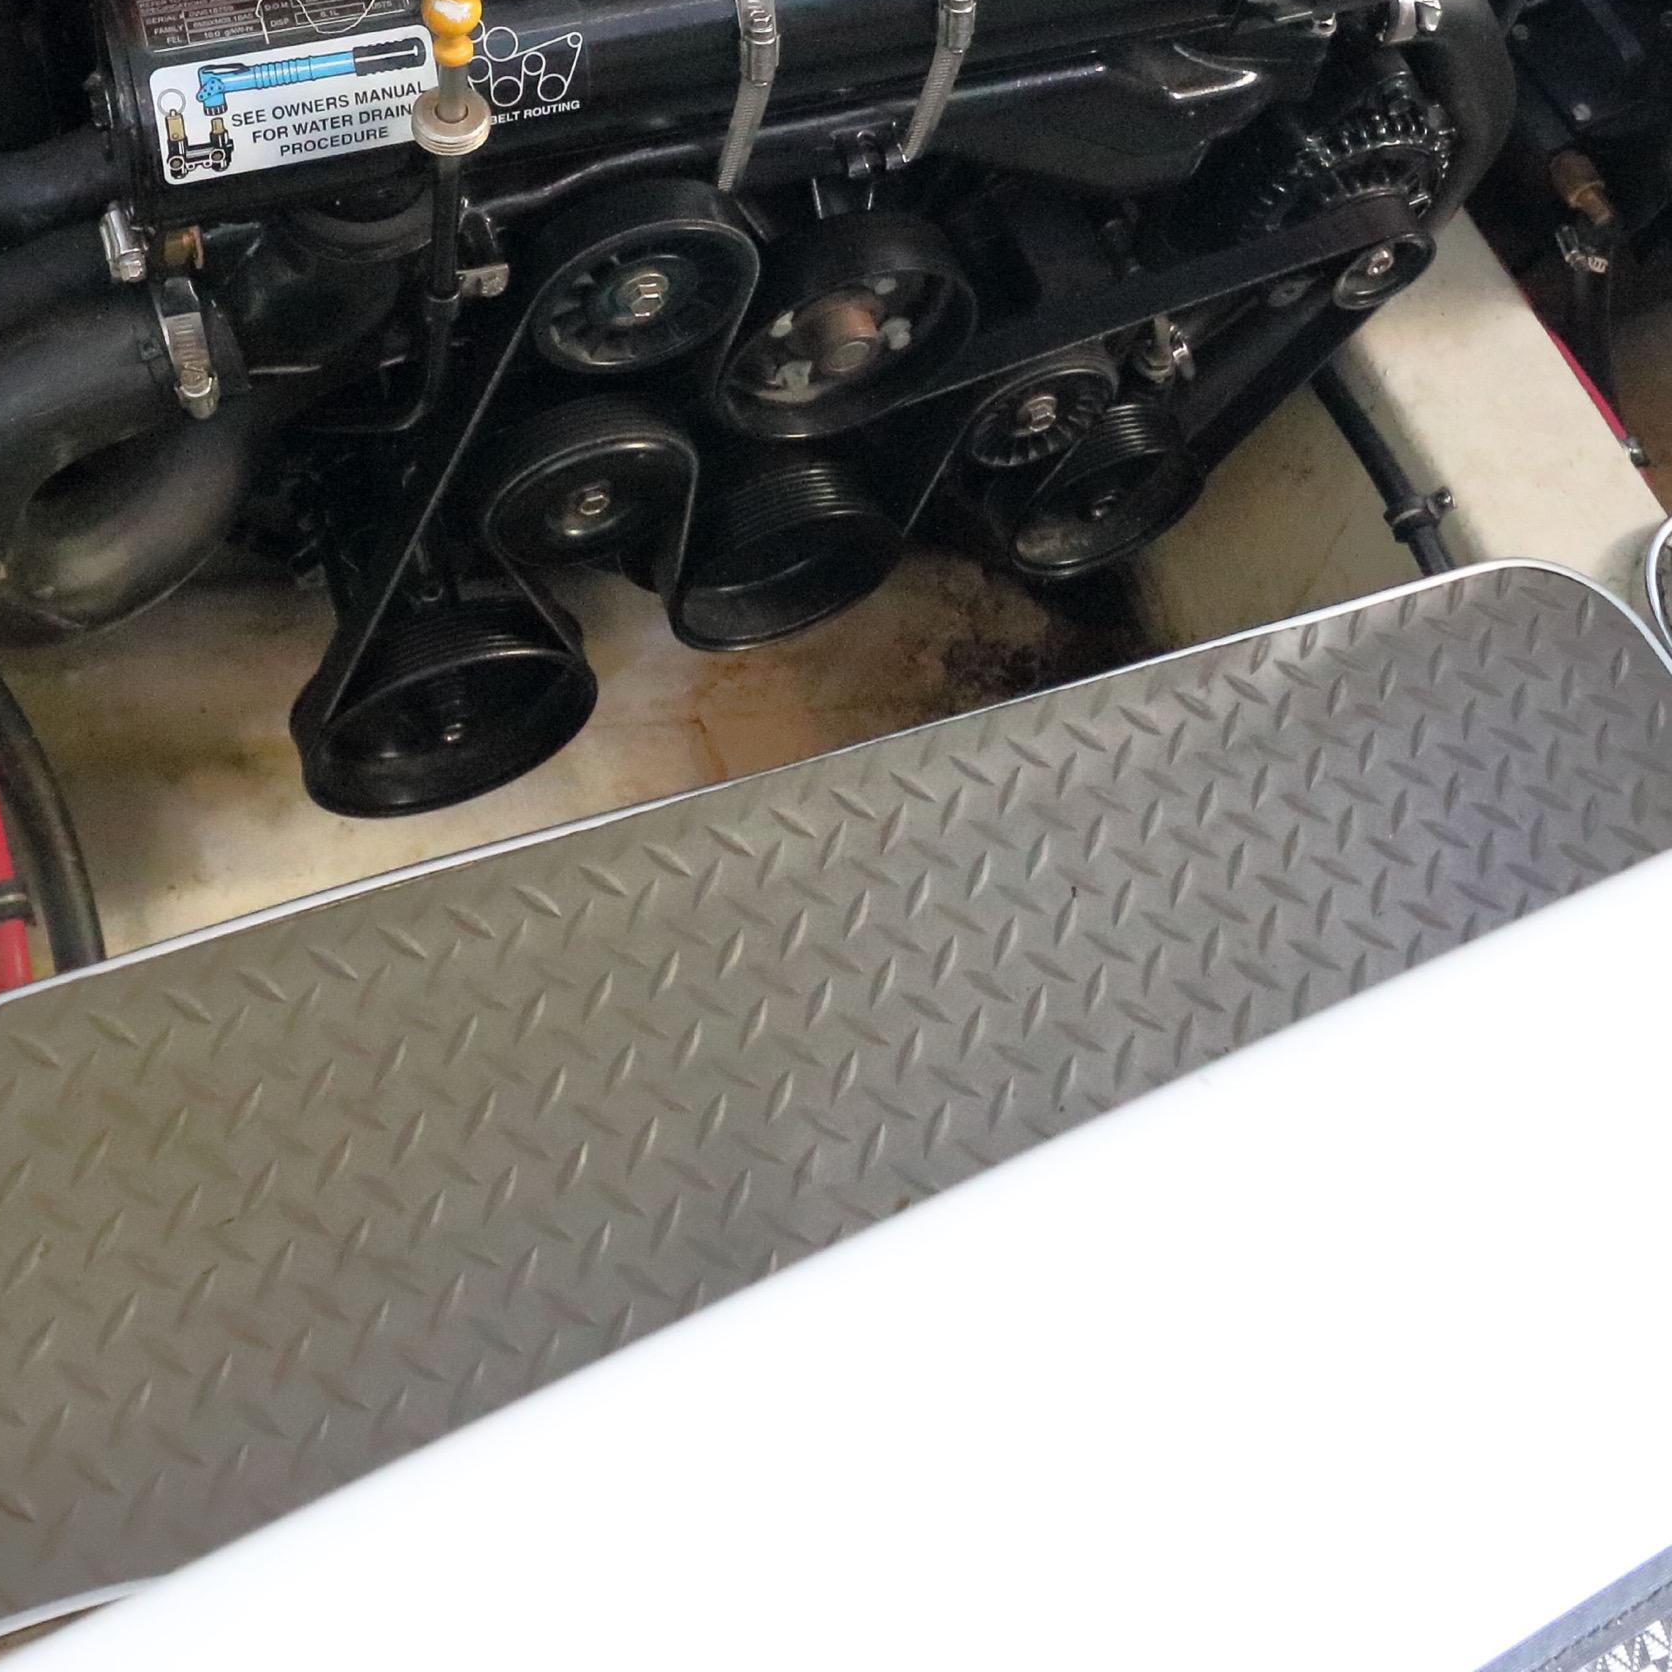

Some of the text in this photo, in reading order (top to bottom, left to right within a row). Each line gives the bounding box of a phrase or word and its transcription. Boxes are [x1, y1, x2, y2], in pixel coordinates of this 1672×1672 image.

[146, 14, 173, 23] SERIAL
[153, 25, 184, 36] FAMILY
[231, 81, 427, 127] SEE OWNERS MANUAL
[490, 100, 580, 126] BELT ROUTING
[252, 104, 413, 144] FOR WATER DRAIN
[280, 127, 389, 157] PROCEDURE
